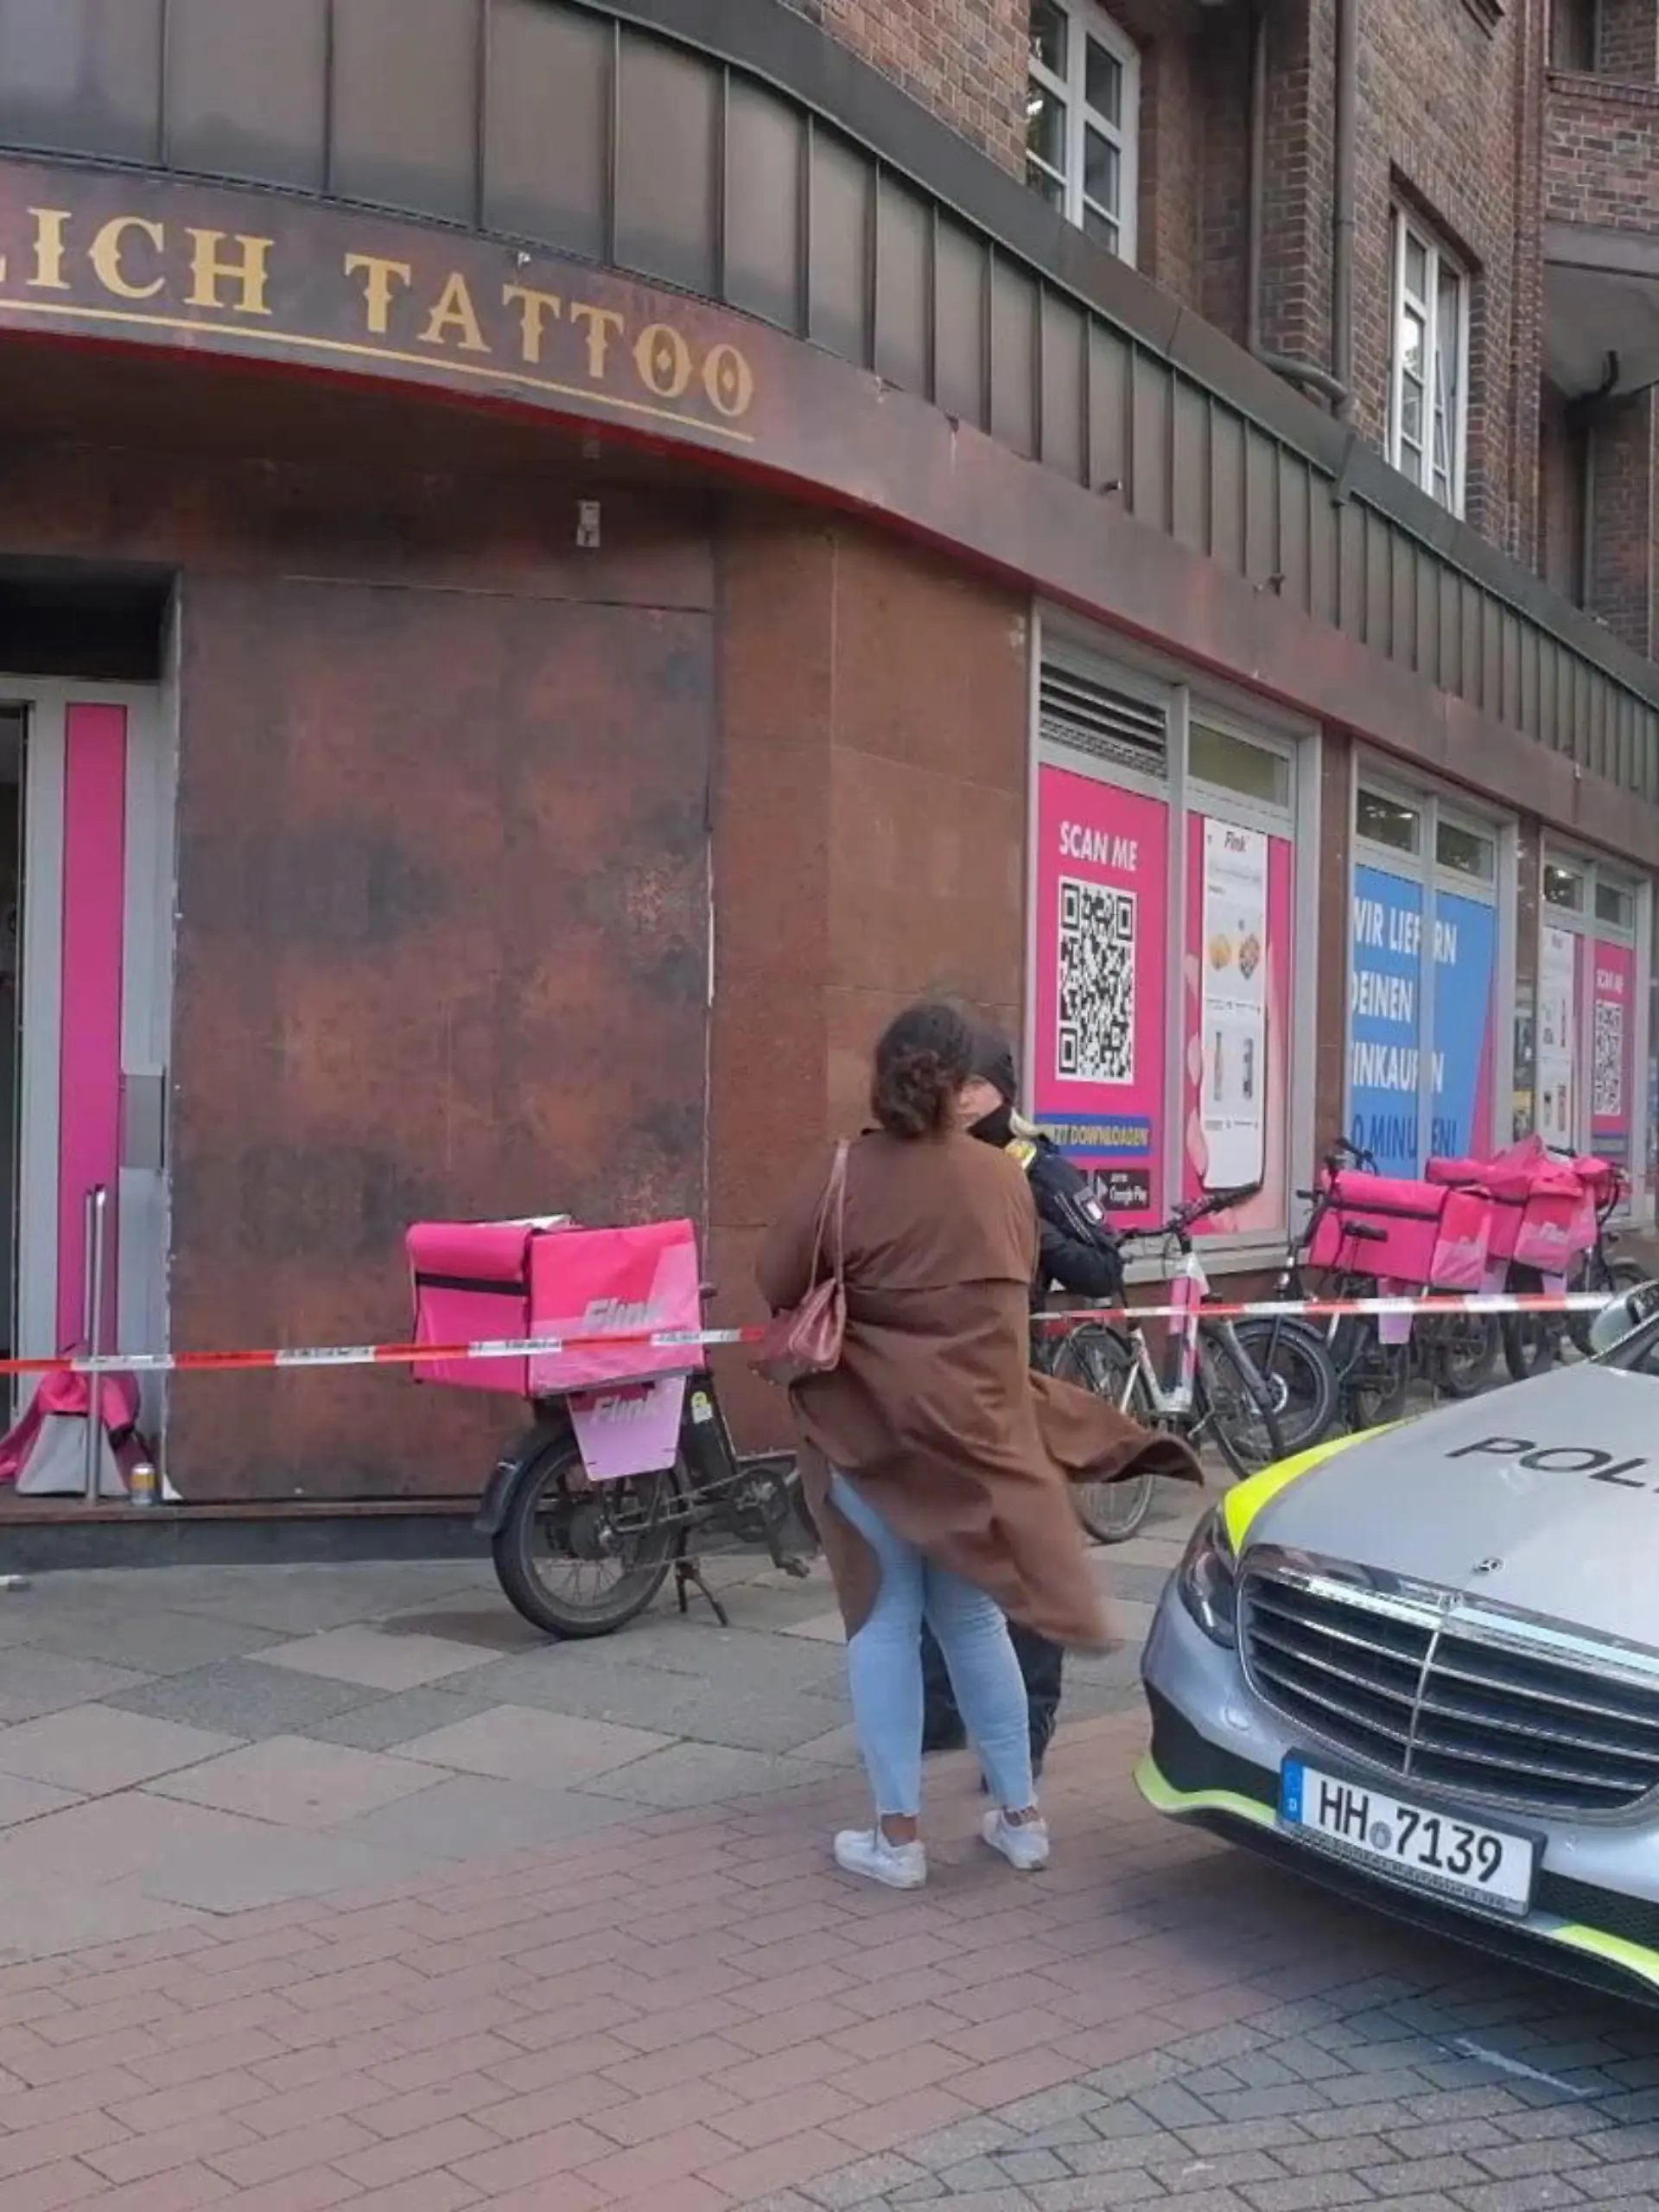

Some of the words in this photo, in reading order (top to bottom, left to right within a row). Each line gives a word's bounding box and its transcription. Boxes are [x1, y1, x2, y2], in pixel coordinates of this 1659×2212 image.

[0, 207, 275, 315] ICH
[344, 252, 754, 417] TATTOO
[1058, 820, 1109, 865] SCAN
[1111, 835, 1138, 871] ME
[1389, 907, 1458, 966] LIEFRN
[1370, 1113, 1457, 1159] MINUEN!
[1445, 1437, 1659, 1494] POL
[1319, 1780, 1369, 1841] HH
[1395, 1807, 1503, 1883] 7139
